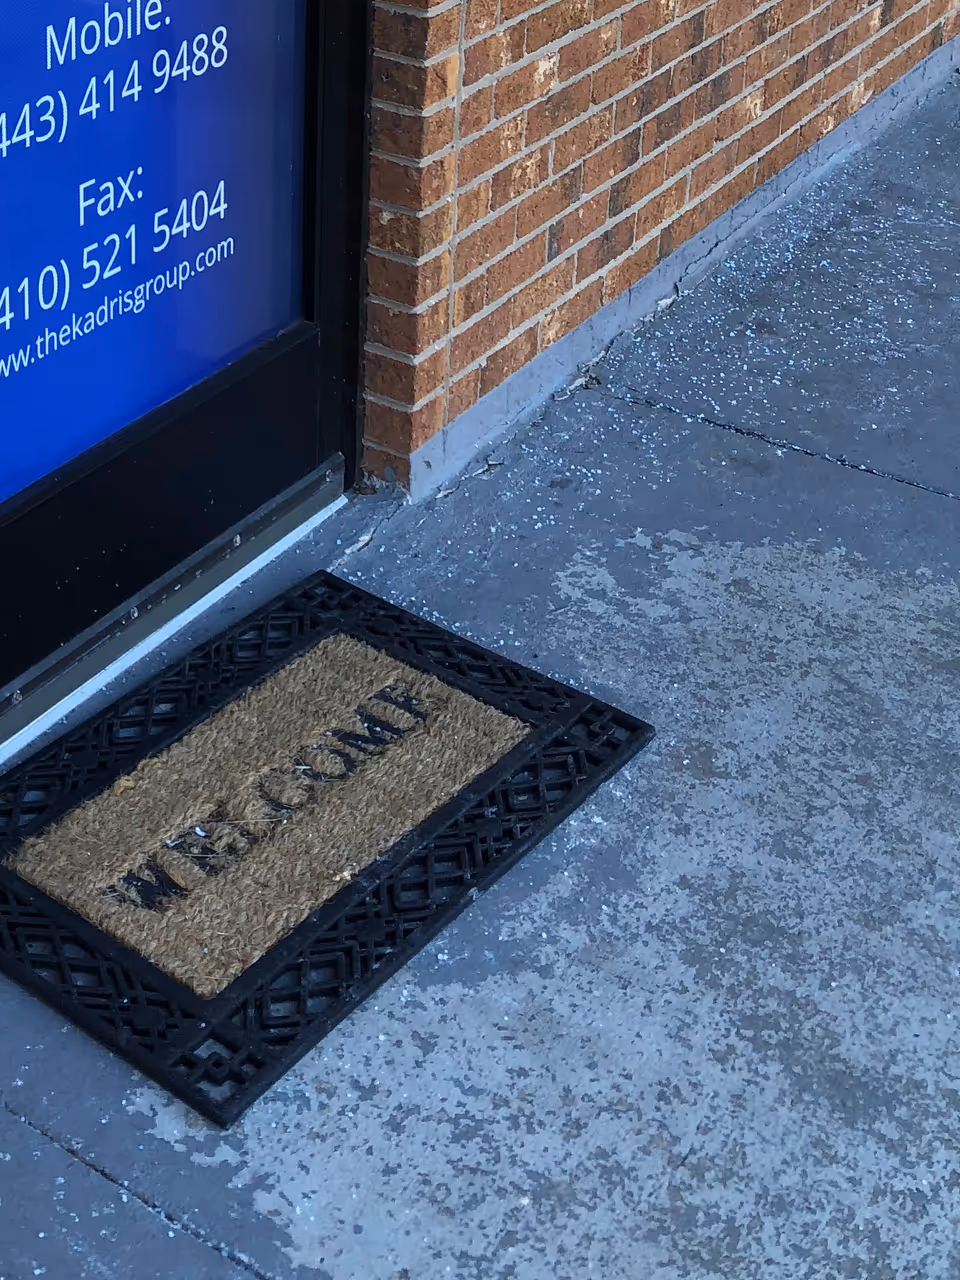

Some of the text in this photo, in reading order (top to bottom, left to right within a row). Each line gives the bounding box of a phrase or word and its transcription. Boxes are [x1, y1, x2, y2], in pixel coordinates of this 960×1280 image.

[79, 59, 141, 121] 414
[152, 25, 228, 95] 9488
[79, 166, 143, 226] Fax:
[82, 223, 138, 290] 521
[152, 180, 228, 254] 5404
